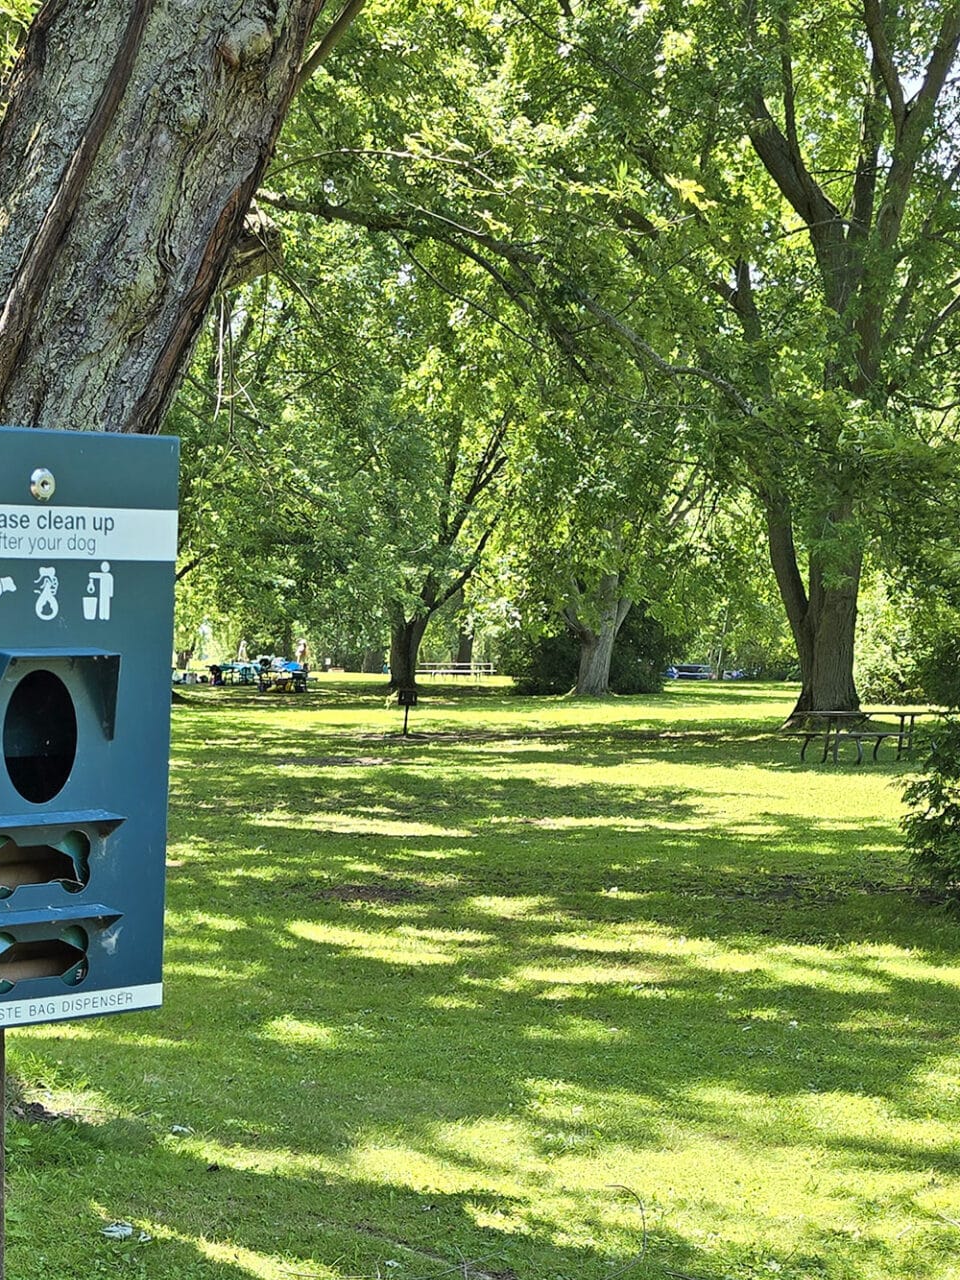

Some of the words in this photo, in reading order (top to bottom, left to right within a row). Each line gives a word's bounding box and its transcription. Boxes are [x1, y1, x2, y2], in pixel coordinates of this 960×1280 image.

[37, 510, 86, 530] clean
[93, 516, 115, 536] up
[28, 536, 62, 555] your
[67, 534, 97, 555] dog
[29, 1003, 56, 1017] BAG
[62, 992, 134, 1013] DISPENSER
